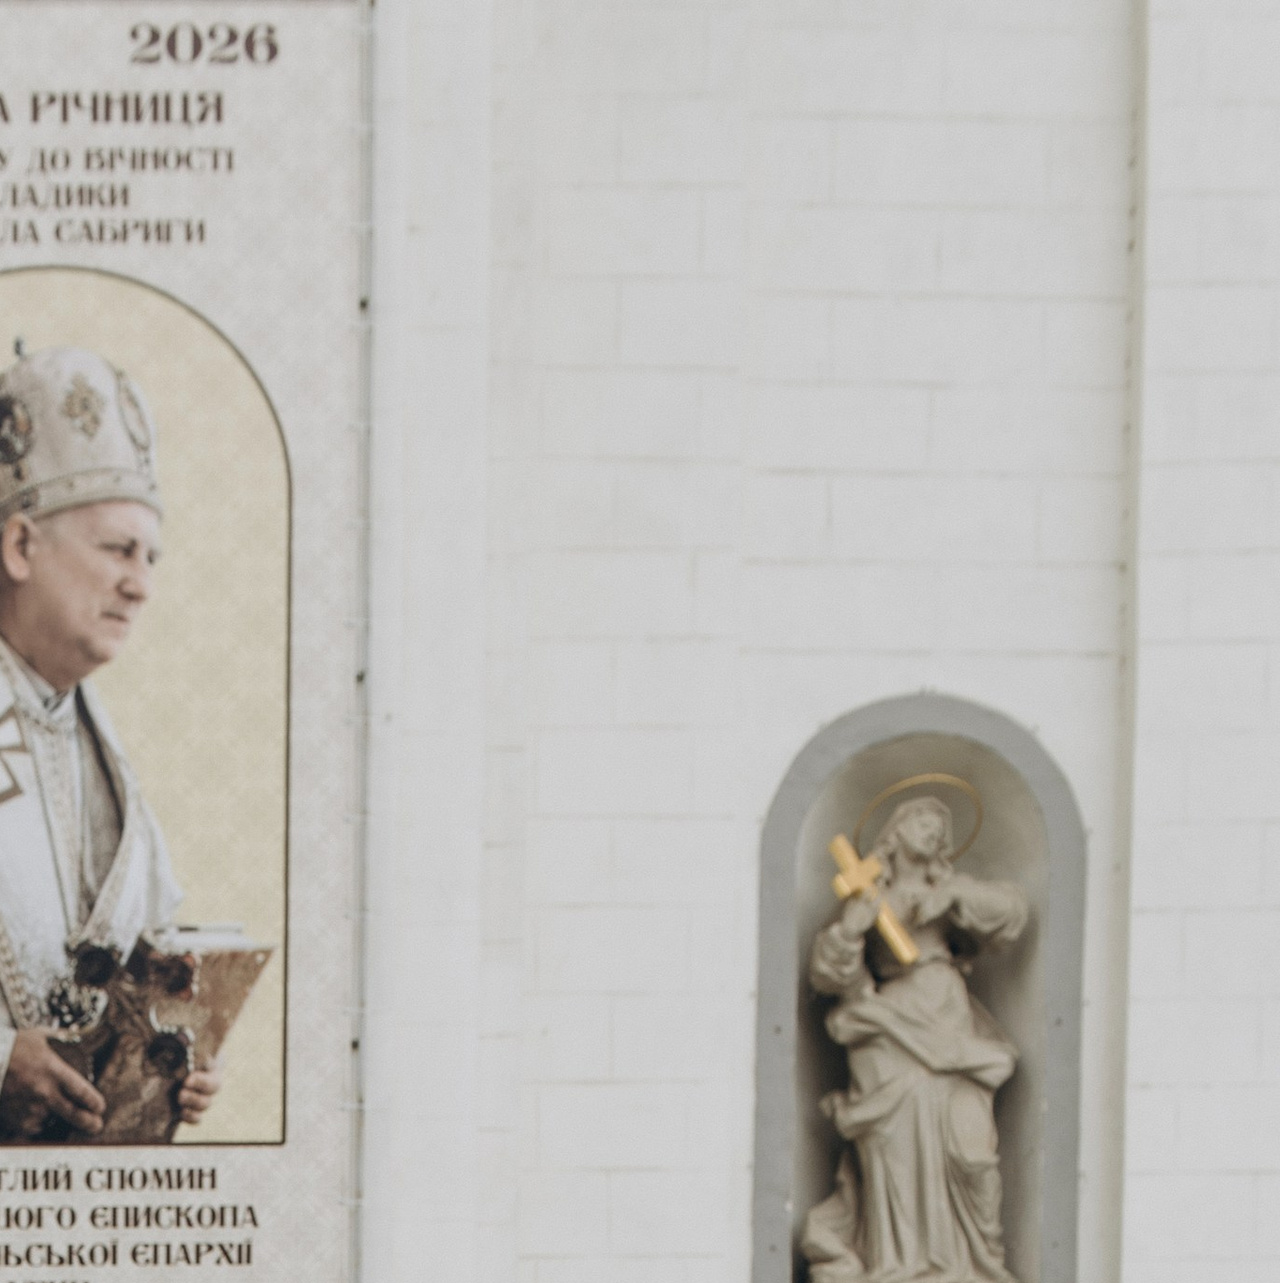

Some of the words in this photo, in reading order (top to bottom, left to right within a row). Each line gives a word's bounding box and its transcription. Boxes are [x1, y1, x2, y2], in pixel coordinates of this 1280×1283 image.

[128, 22, 281, 66] 2026
[28, 90, 224, 128] РІЧНИЦЯ
[27, 146, 73, 177] ДО
[82, 146, 235, 175] ВІЧНОСТІ
[53, 218, 206, 246] САБРИГИ
[83, 1166, 218, 1194] СПОМИН
[88, 1203, 260, 1231] ЄПИСКОПА
[129, 1239, 254, 1268] ЄПАРХІЇ
